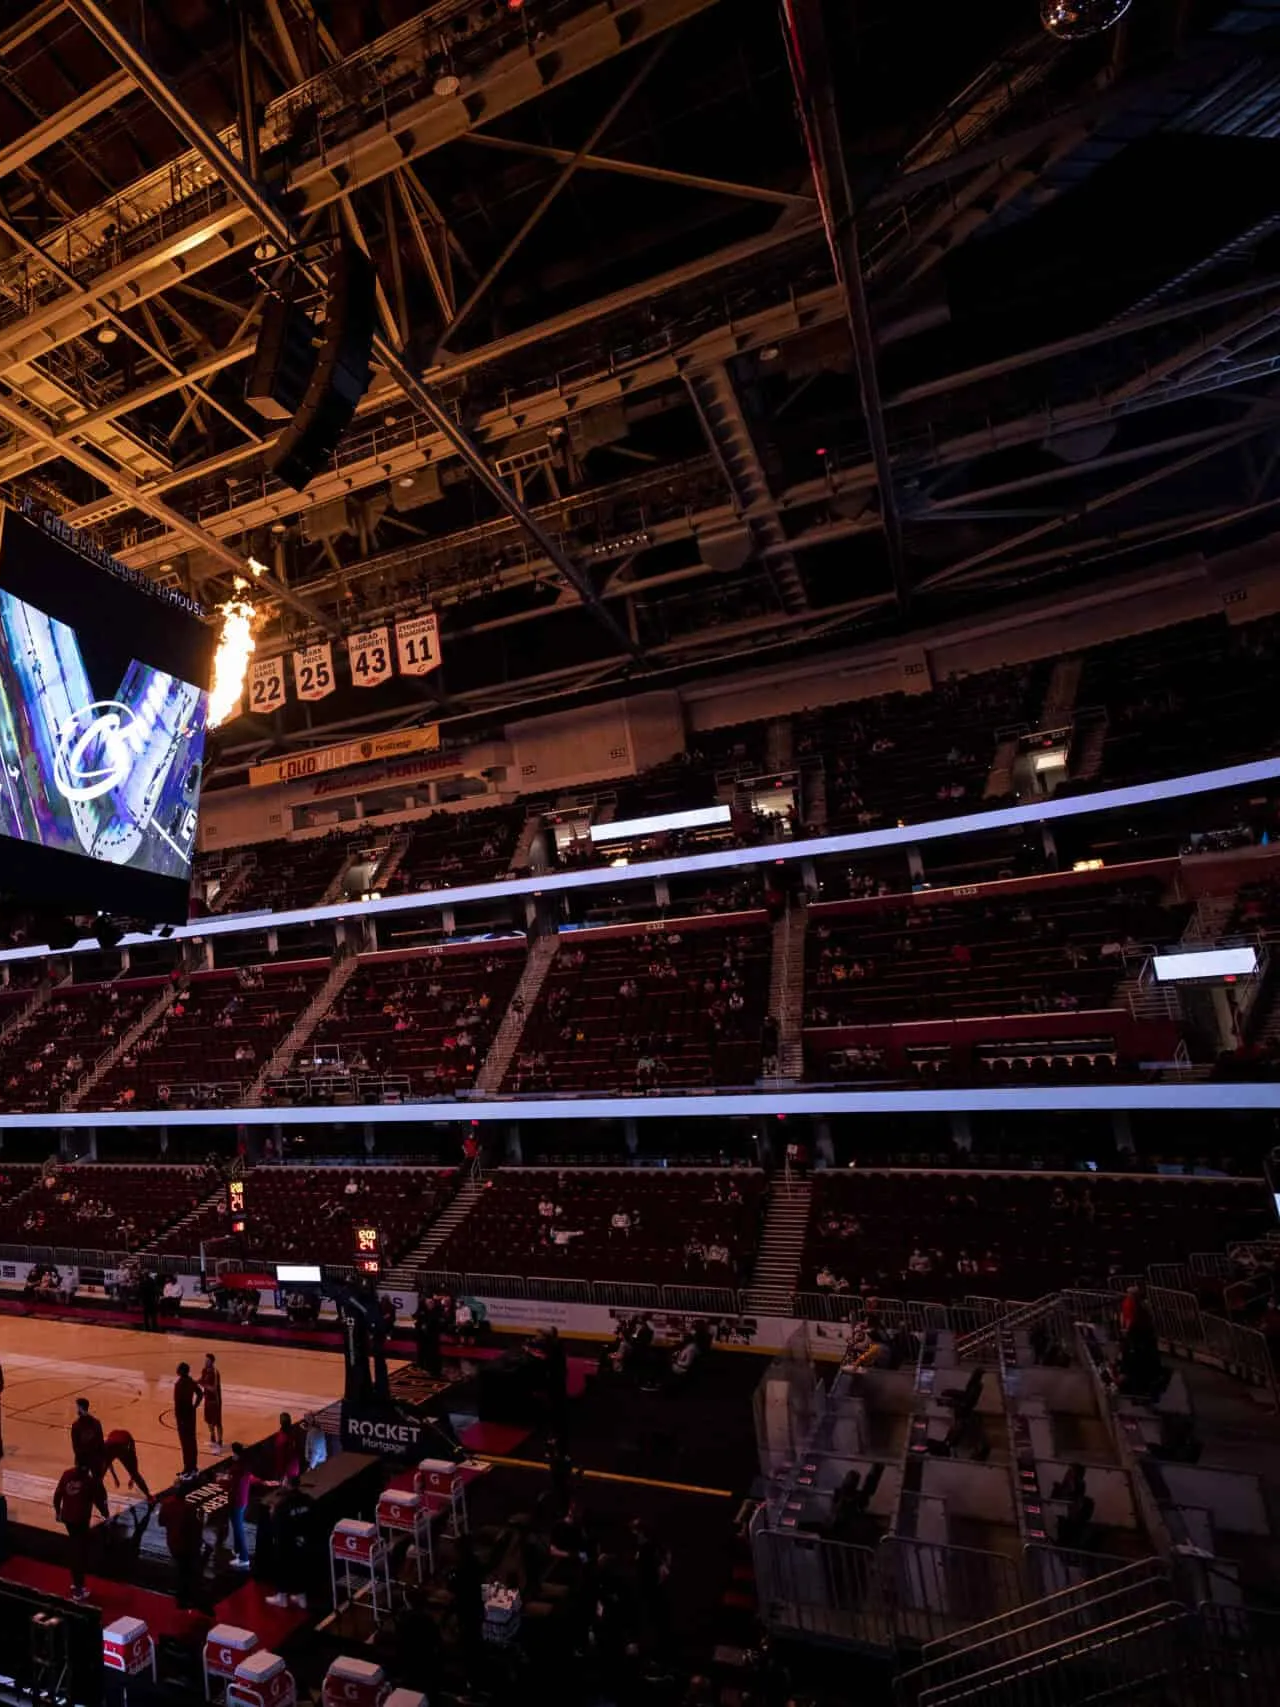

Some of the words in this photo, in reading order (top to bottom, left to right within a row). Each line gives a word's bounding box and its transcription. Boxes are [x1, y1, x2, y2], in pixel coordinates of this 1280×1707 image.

[406, 636, 432, 665] 11
[356, 647, 385, 676] 43
[300, 662, 329, 692] 25
[253, 676, 280, 704] 22
[348, 1418, 422, 1443] ROCKET
[429, 1472, 441, 1486] G
[389, 1504, 402, 1520] G
[345, 1536, 358, 1550] G
[220, 1648, 233, 1665] G
[343, 1682, 359, 1699] G
